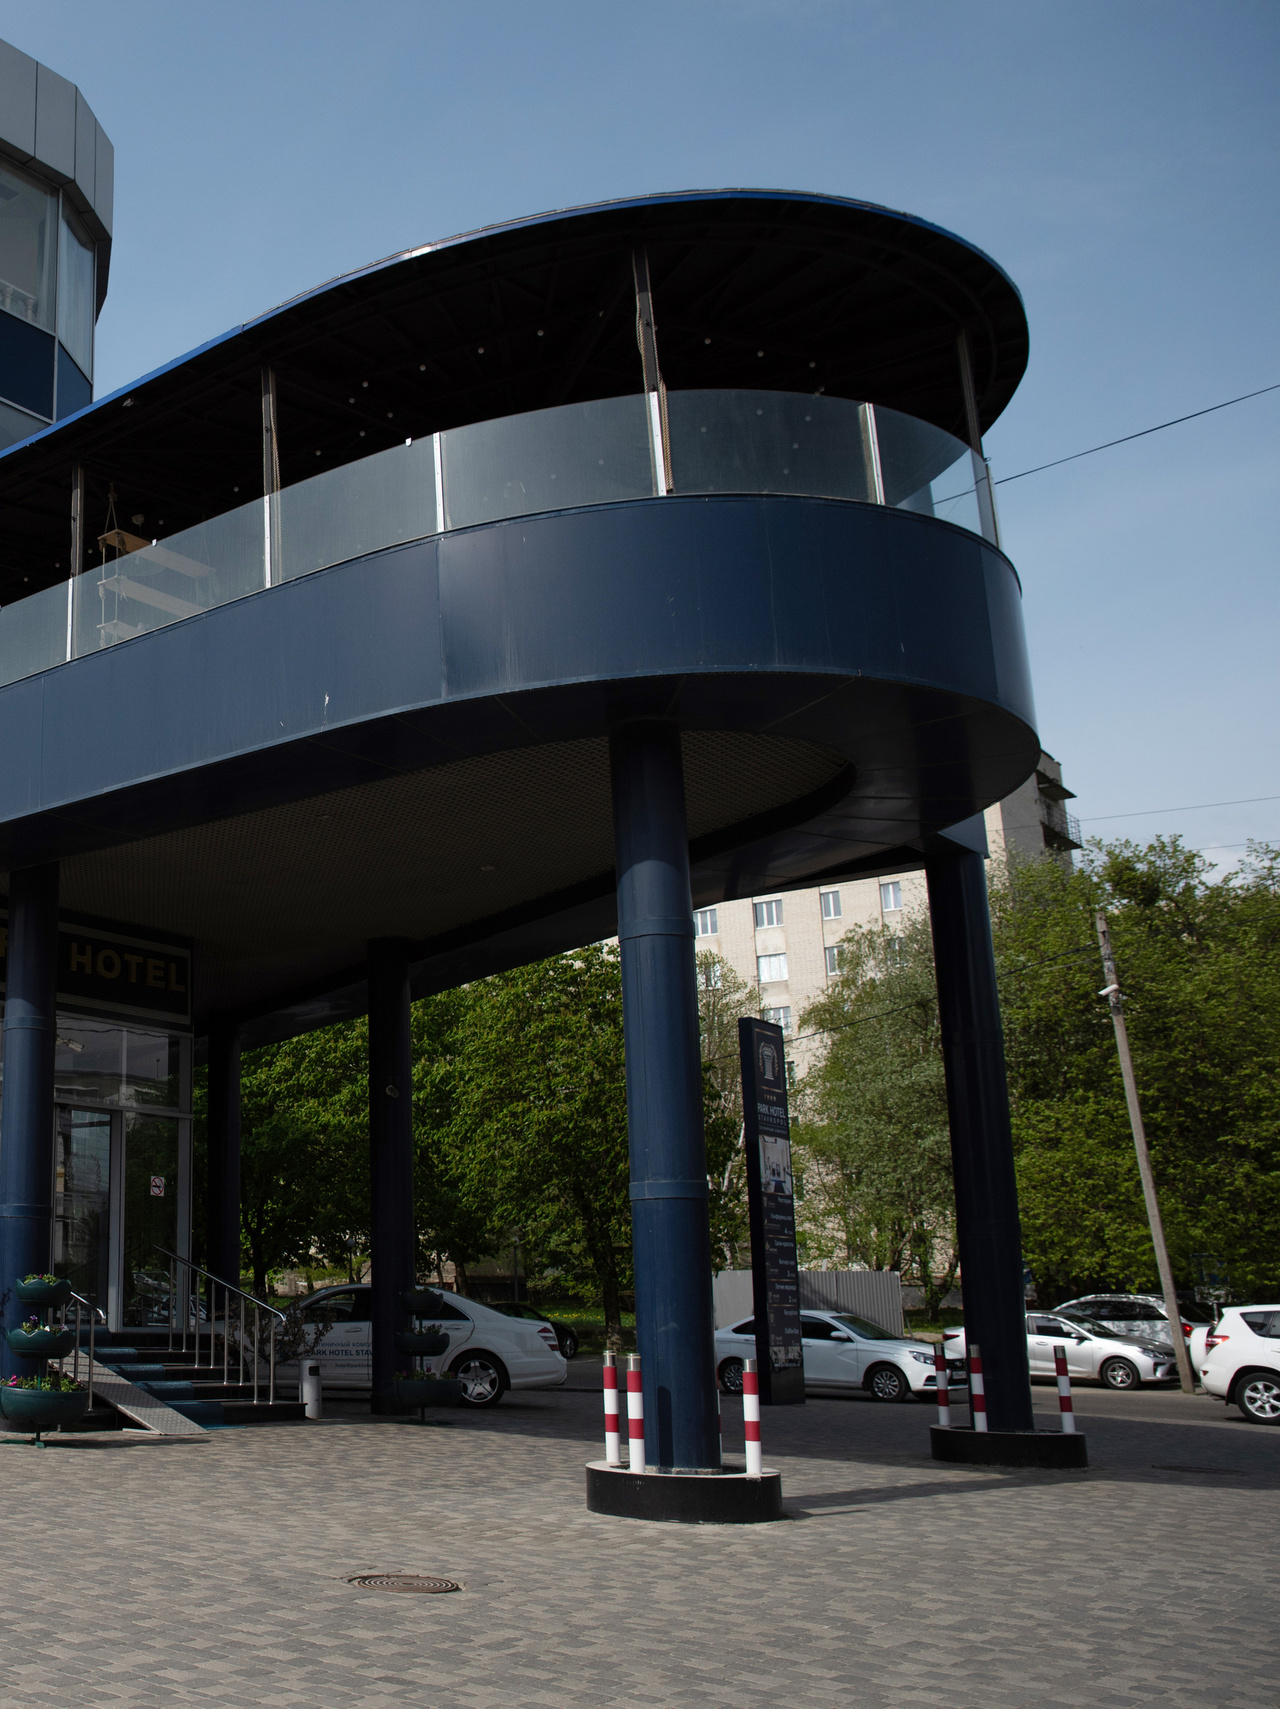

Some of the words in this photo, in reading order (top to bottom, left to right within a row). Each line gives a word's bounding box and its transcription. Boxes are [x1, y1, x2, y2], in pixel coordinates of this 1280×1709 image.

[69, 942, 187, 993] HOTEL
[757, 1102, 770, 1115] PARK
[769, 1105, 786, 1118] HOTEL
